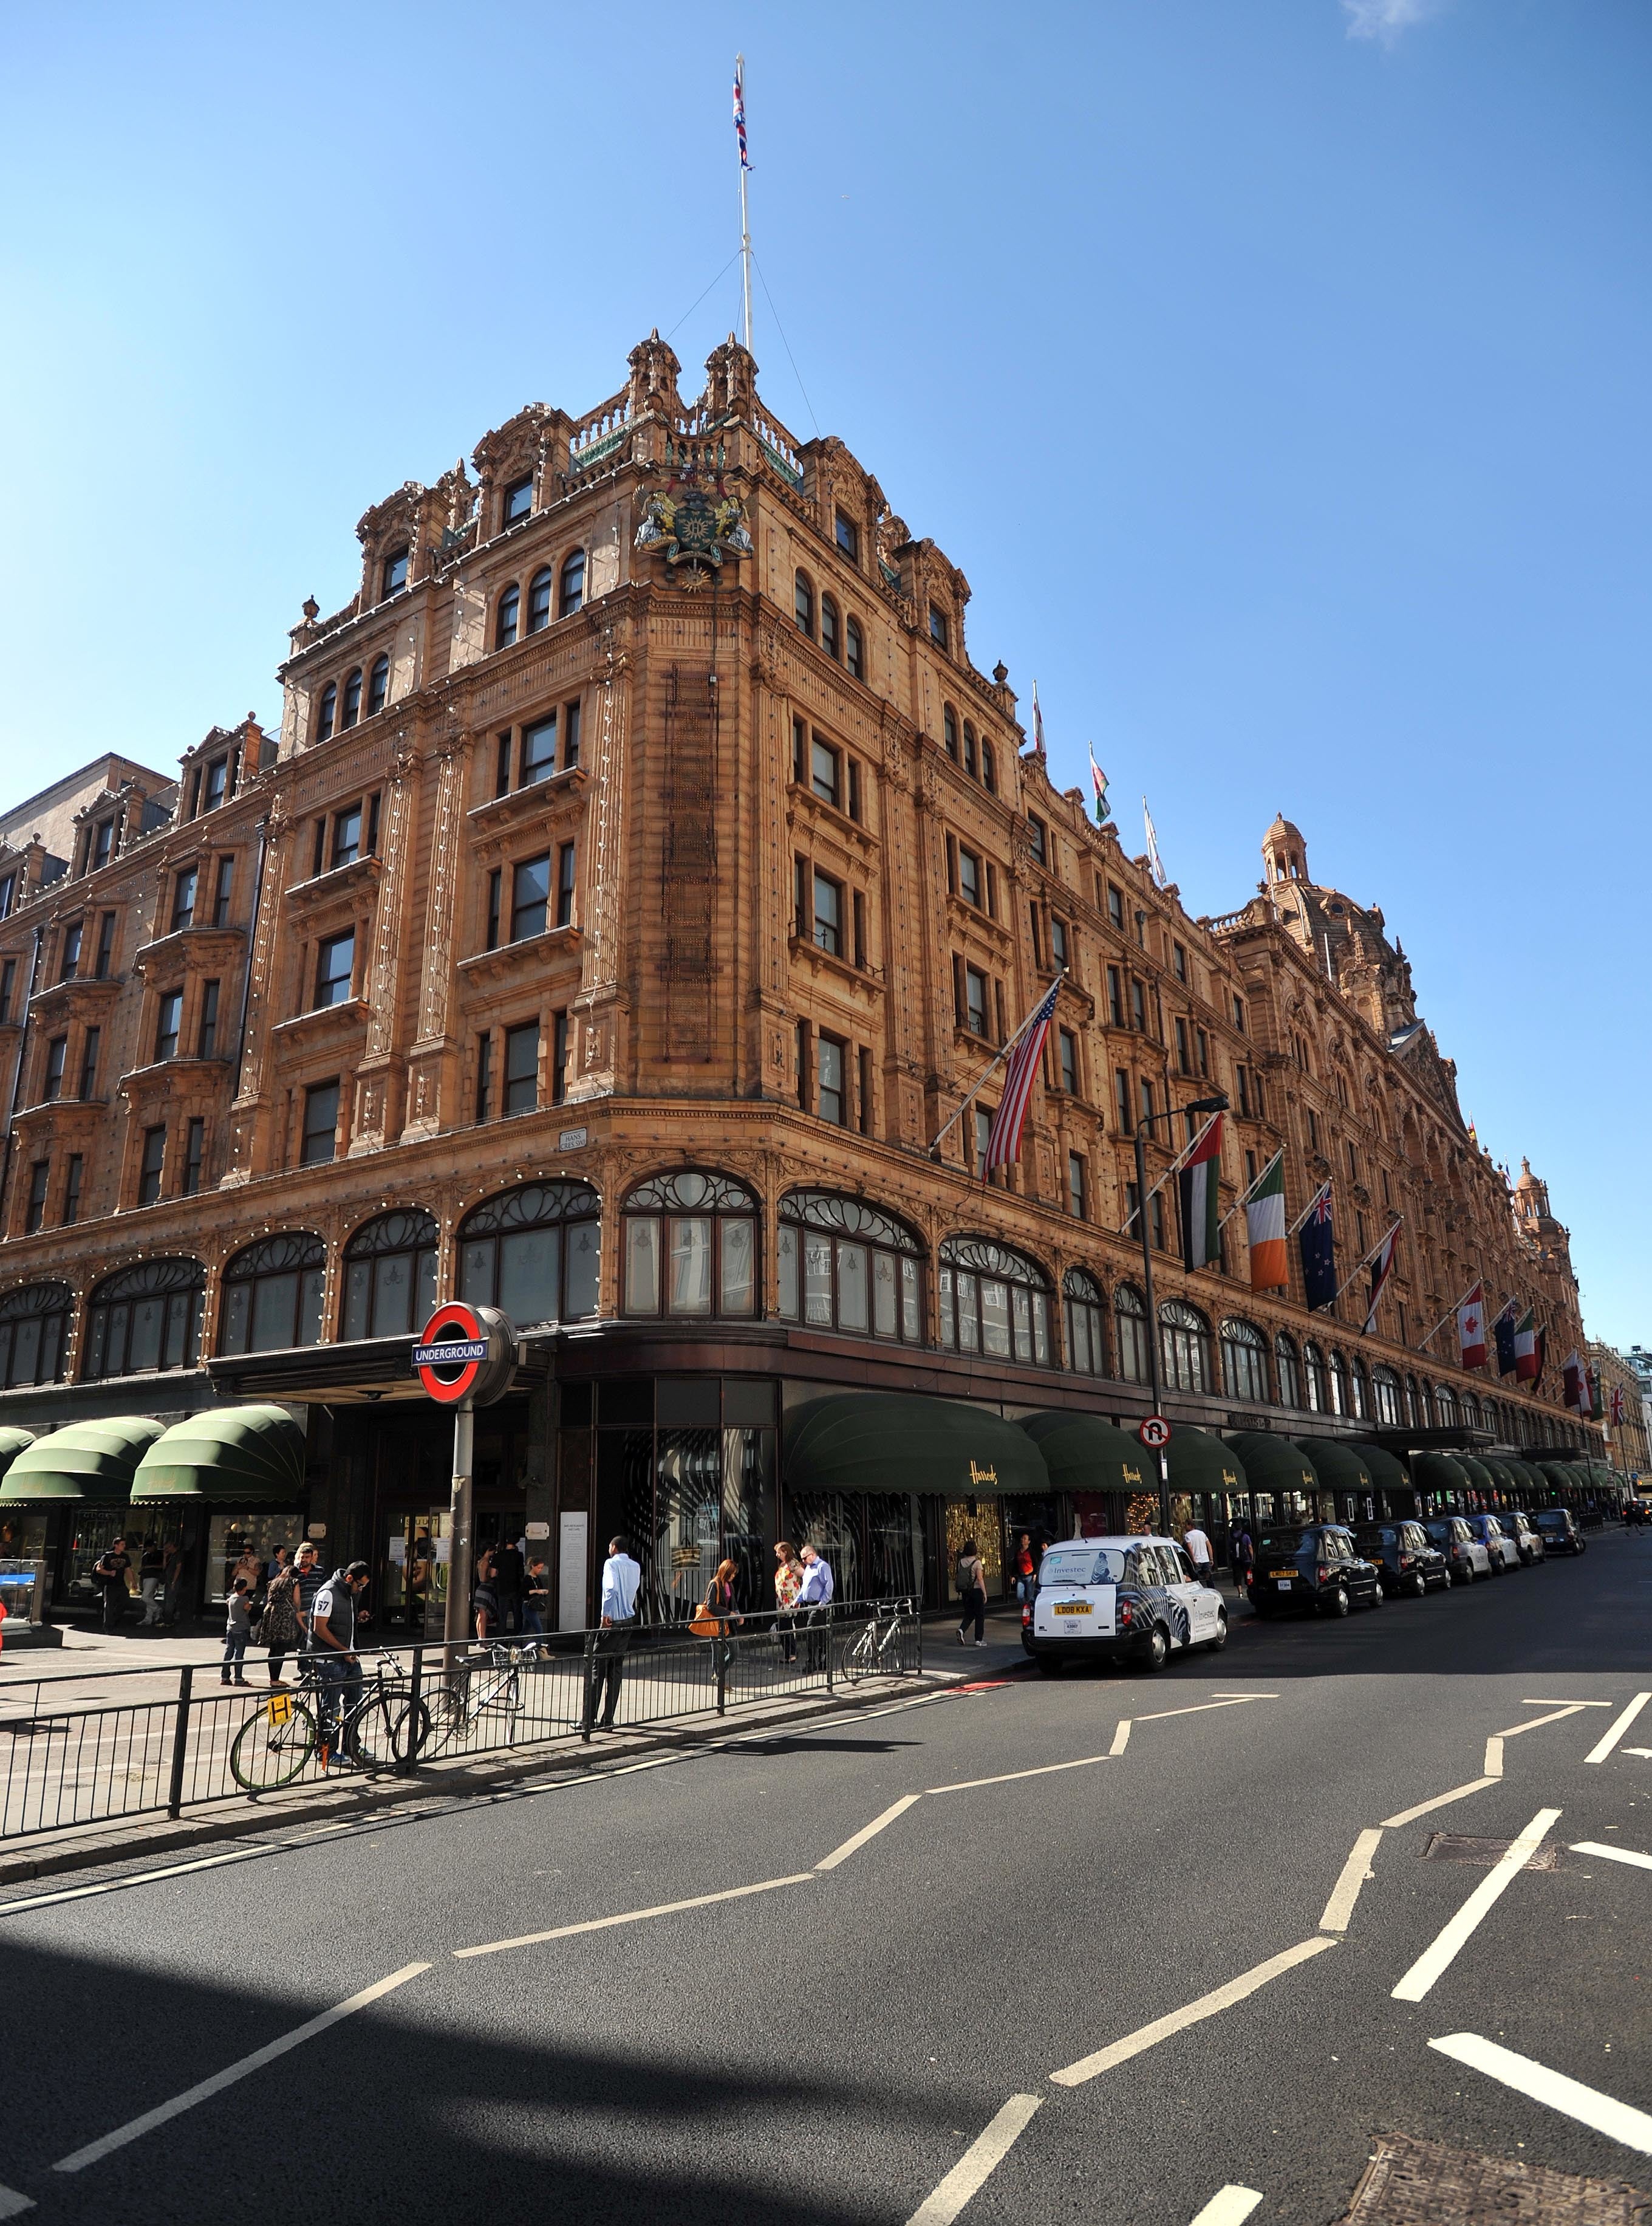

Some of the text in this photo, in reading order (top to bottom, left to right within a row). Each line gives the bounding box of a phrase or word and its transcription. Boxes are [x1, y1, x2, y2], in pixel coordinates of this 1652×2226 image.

[565, 1134, 581, 1142] HANS
[416, 1344, 483, 1361] UNDERGROUND
[969, 1460, 998, 1485] Harrods
[1122, 1464, 1142, 1484] Harrods
[317, 1600, 330, 1612] 67
[271, 1696, 288, 1724] H
